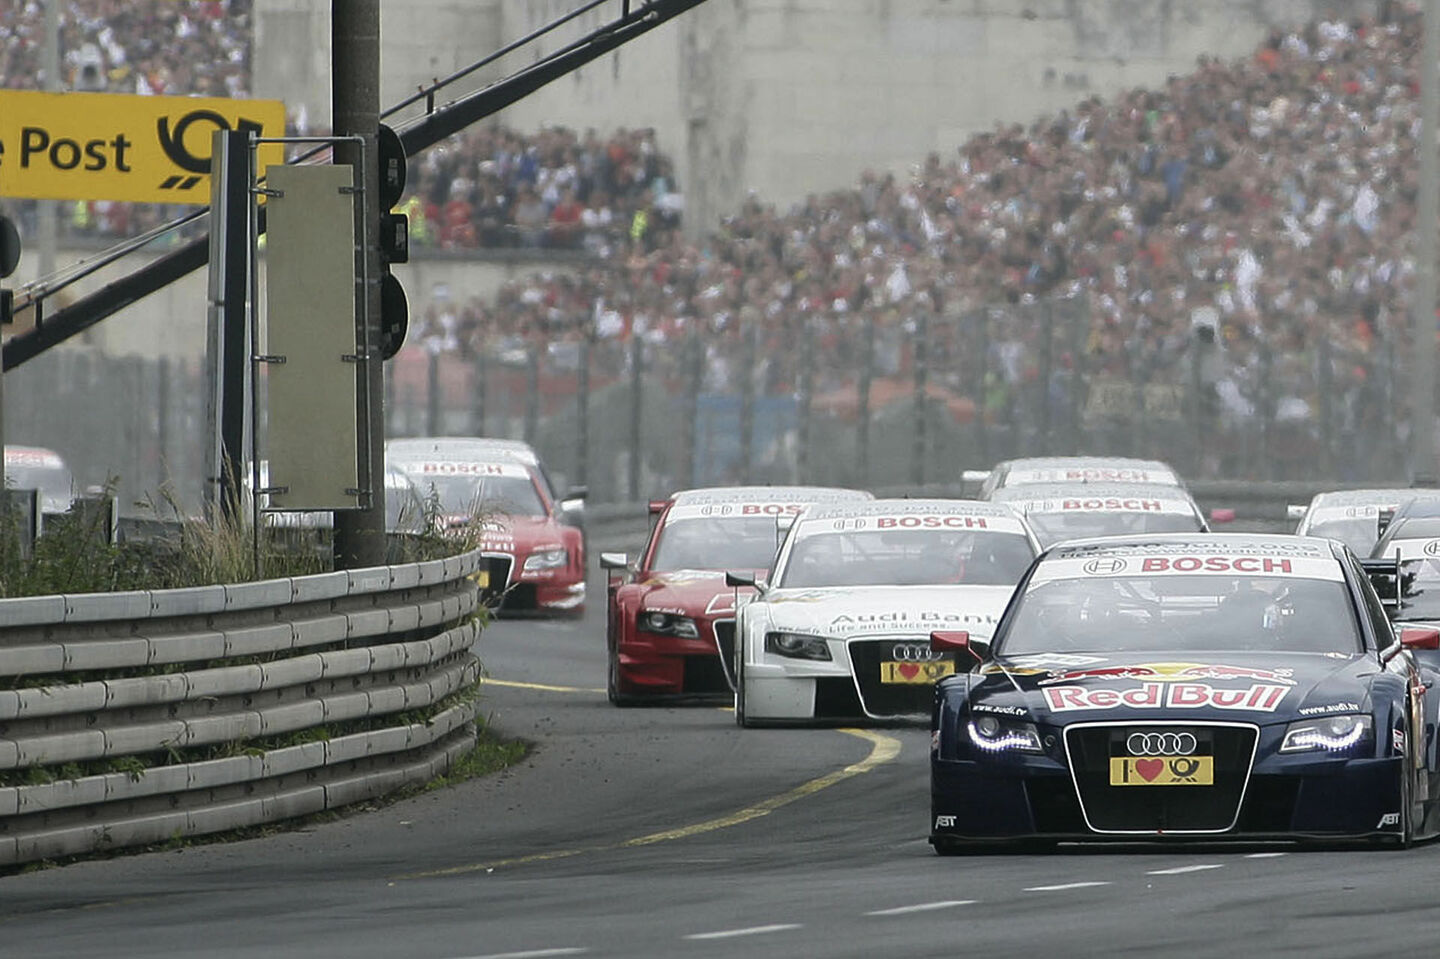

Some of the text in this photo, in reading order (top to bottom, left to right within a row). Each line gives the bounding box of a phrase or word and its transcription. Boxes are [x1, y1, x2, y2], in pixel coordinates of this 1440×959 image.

[20, 126, 131, 173] Post
[424, 463, 503, 475] BOSCH
[1066, 471, 1148, 481] BOSCH
[742, 505, 804, 515] BOS
[1063, 500, 1161, 510] BOSCH
[877, 517, 987, 529] BOSCH
[1142, 558, 1292, 573] BOSCH
[832, 612, 907, 625] Audi
[829, 624, 854, 633] Life
[860, 622, 885, 630] and
[1046, 684, 1289, 710] Red Bull
[972, 704, 1028, 716] www.audi.tv
[1299, 703, 1360, 716] www.audi.tv
[935, 815, 957, 830] ABT
[1376, 813, 1401, 829] ABT
